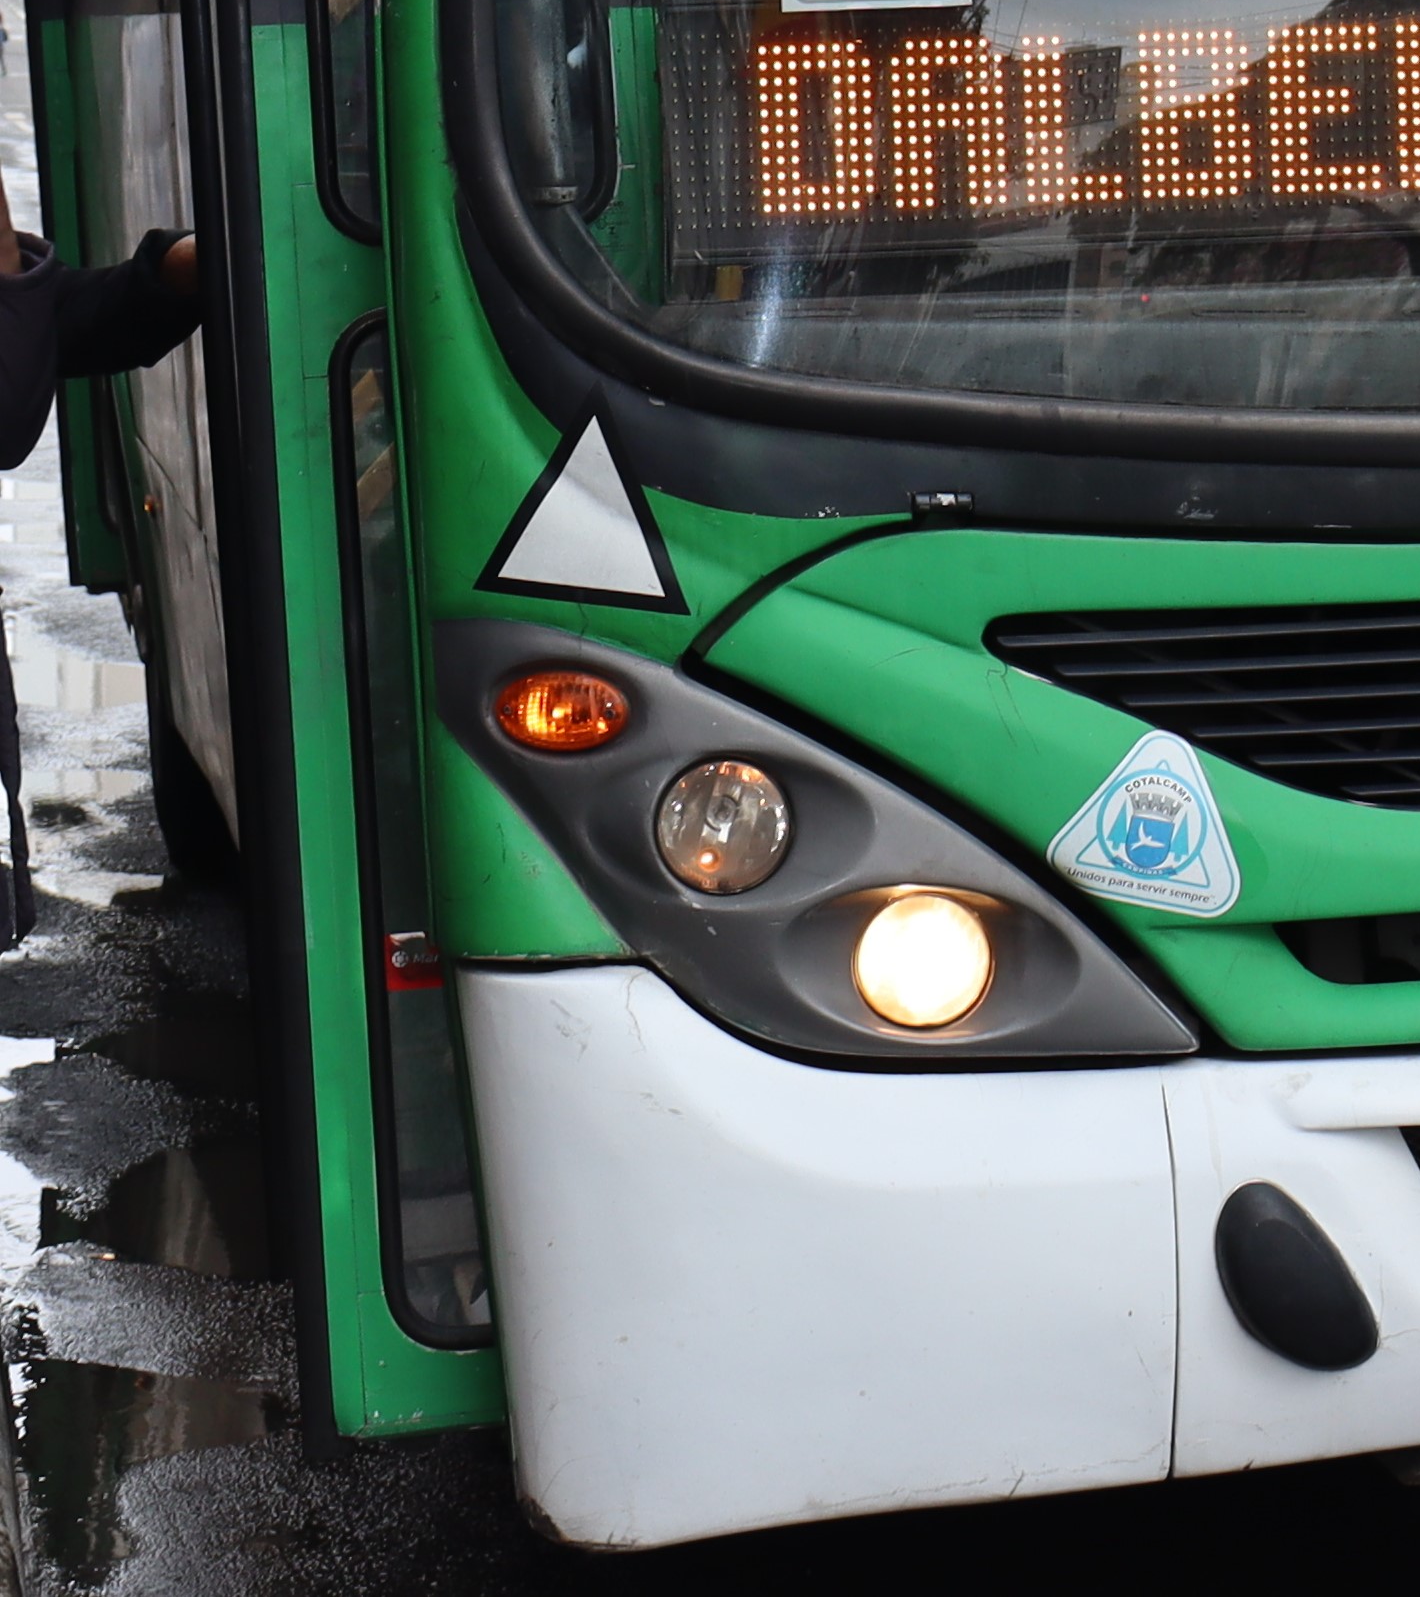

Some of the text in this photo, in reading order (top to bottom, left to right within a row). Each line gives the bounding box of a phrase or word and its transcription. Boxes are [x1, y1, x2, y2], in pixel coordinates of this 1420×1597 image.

[1124, 776, 1192, 804] COTALCAMP
[1108, 877, 1134, 892] para
[1136, 881, 1167, 896] servir
